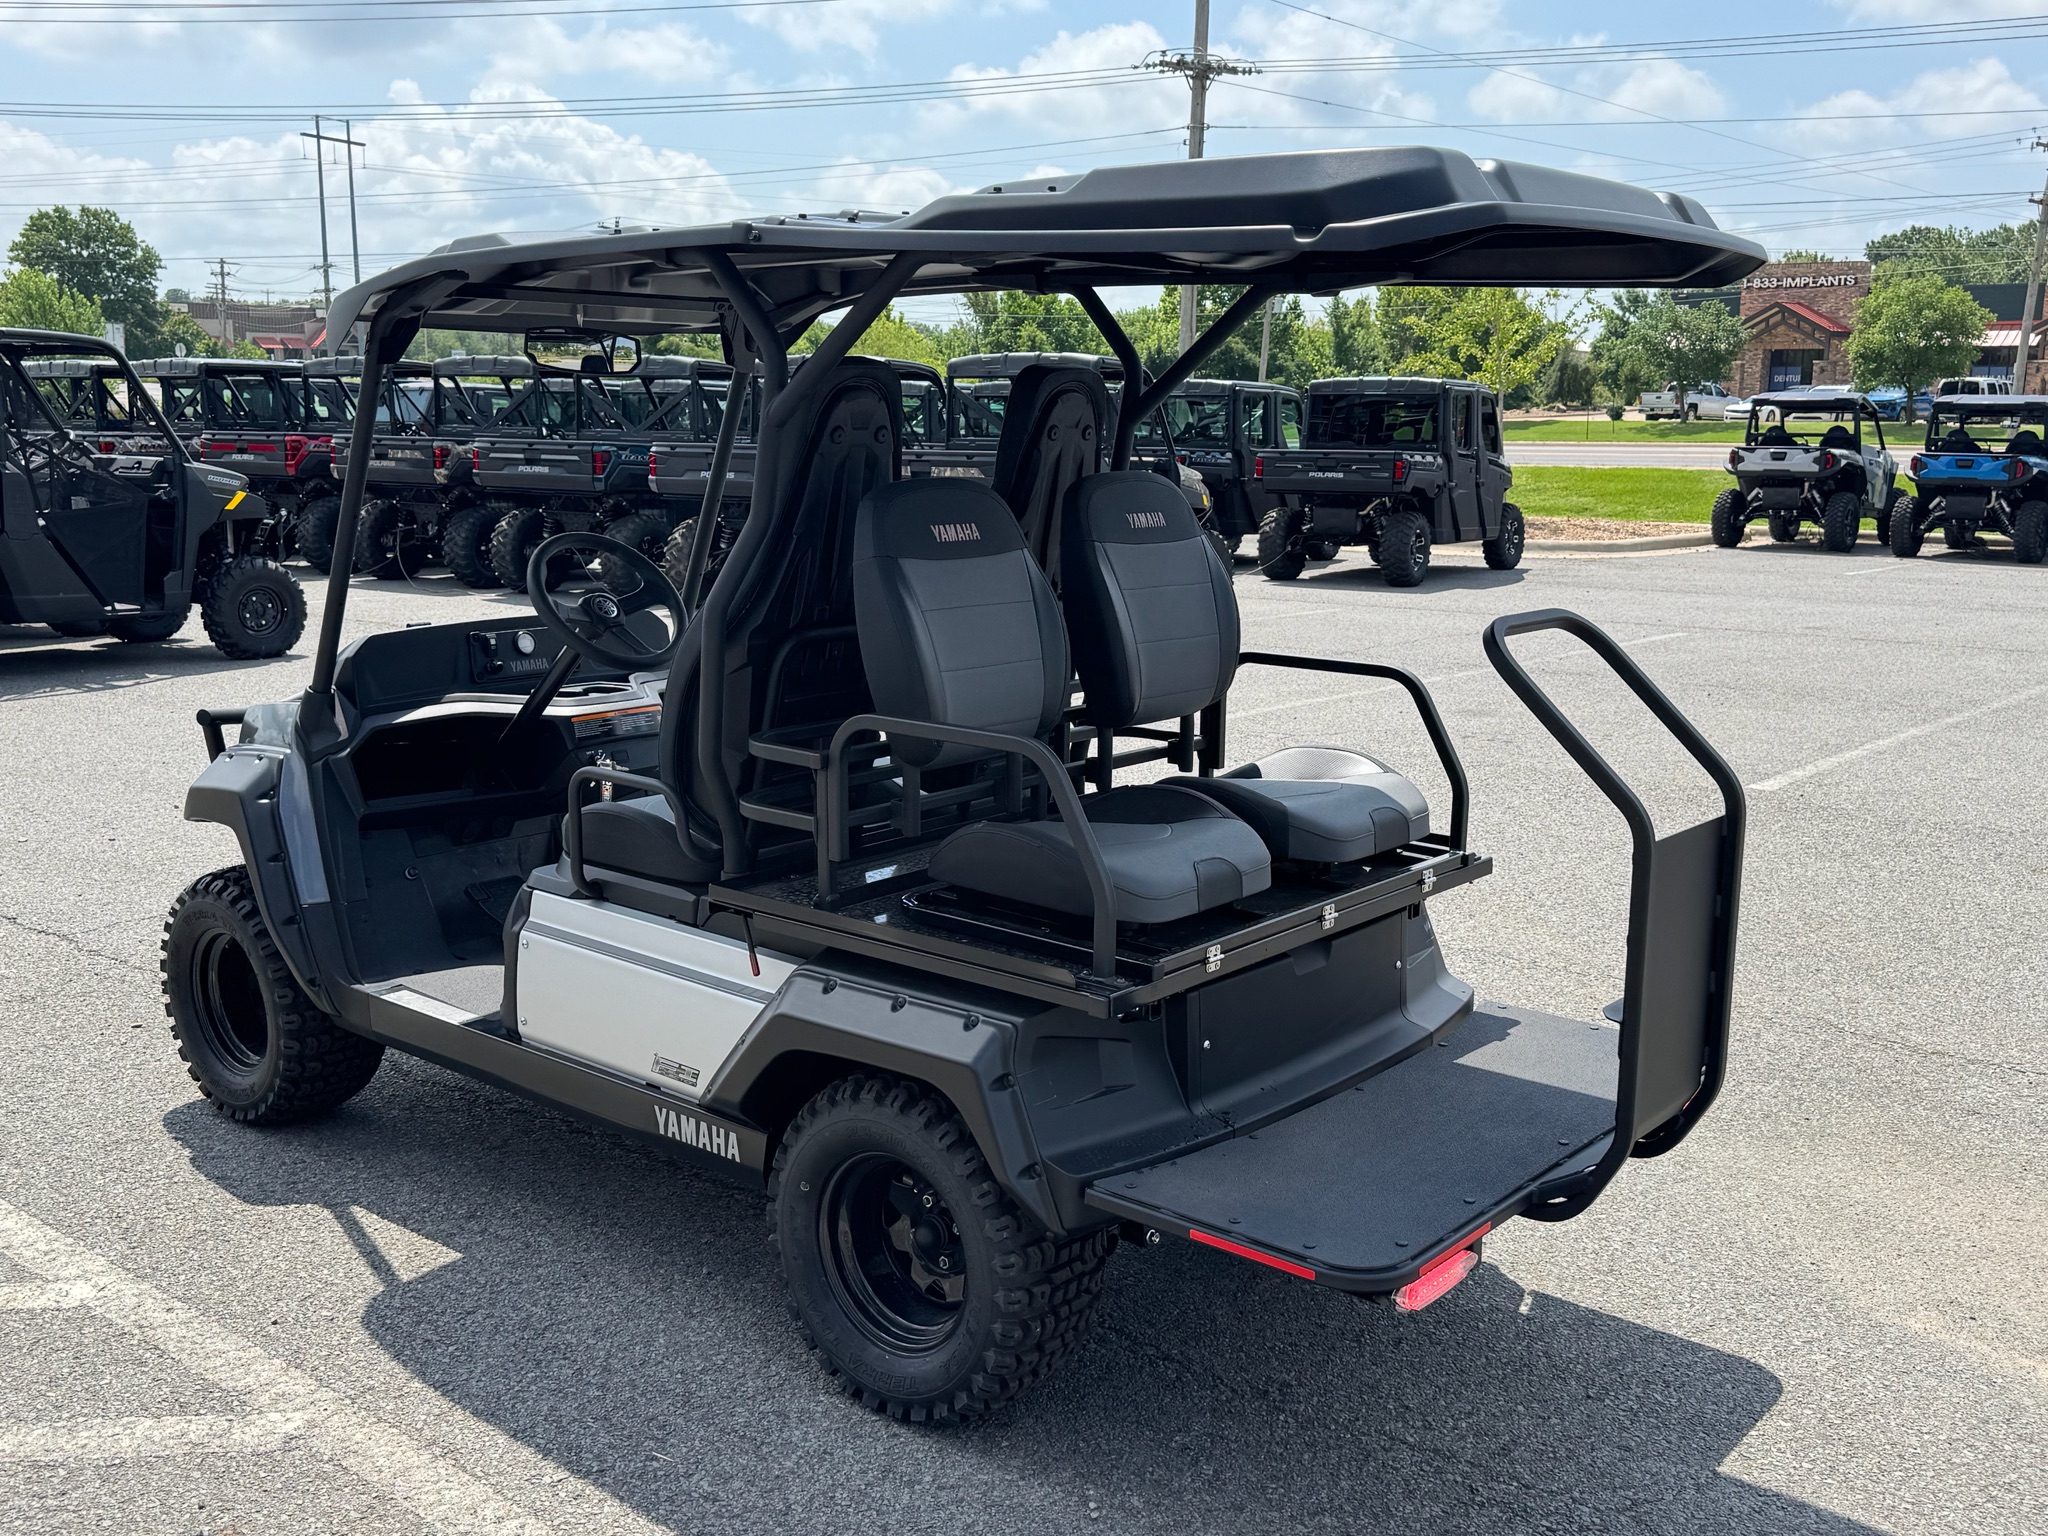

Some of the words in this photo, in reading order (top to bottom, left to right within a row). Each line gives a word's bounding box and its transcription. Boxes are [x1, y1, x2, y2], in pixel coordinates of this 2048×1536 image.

[1742, 275, 1856, 289] 1-833-IMPLANTS
[1125, 512, 1167, 529] YAMAHA
[930, 523, 981, 543] YAMAHA
[509, 658, 549, 673] YAMAHA
[653, 1104, 741, 1164] YAMAHA
